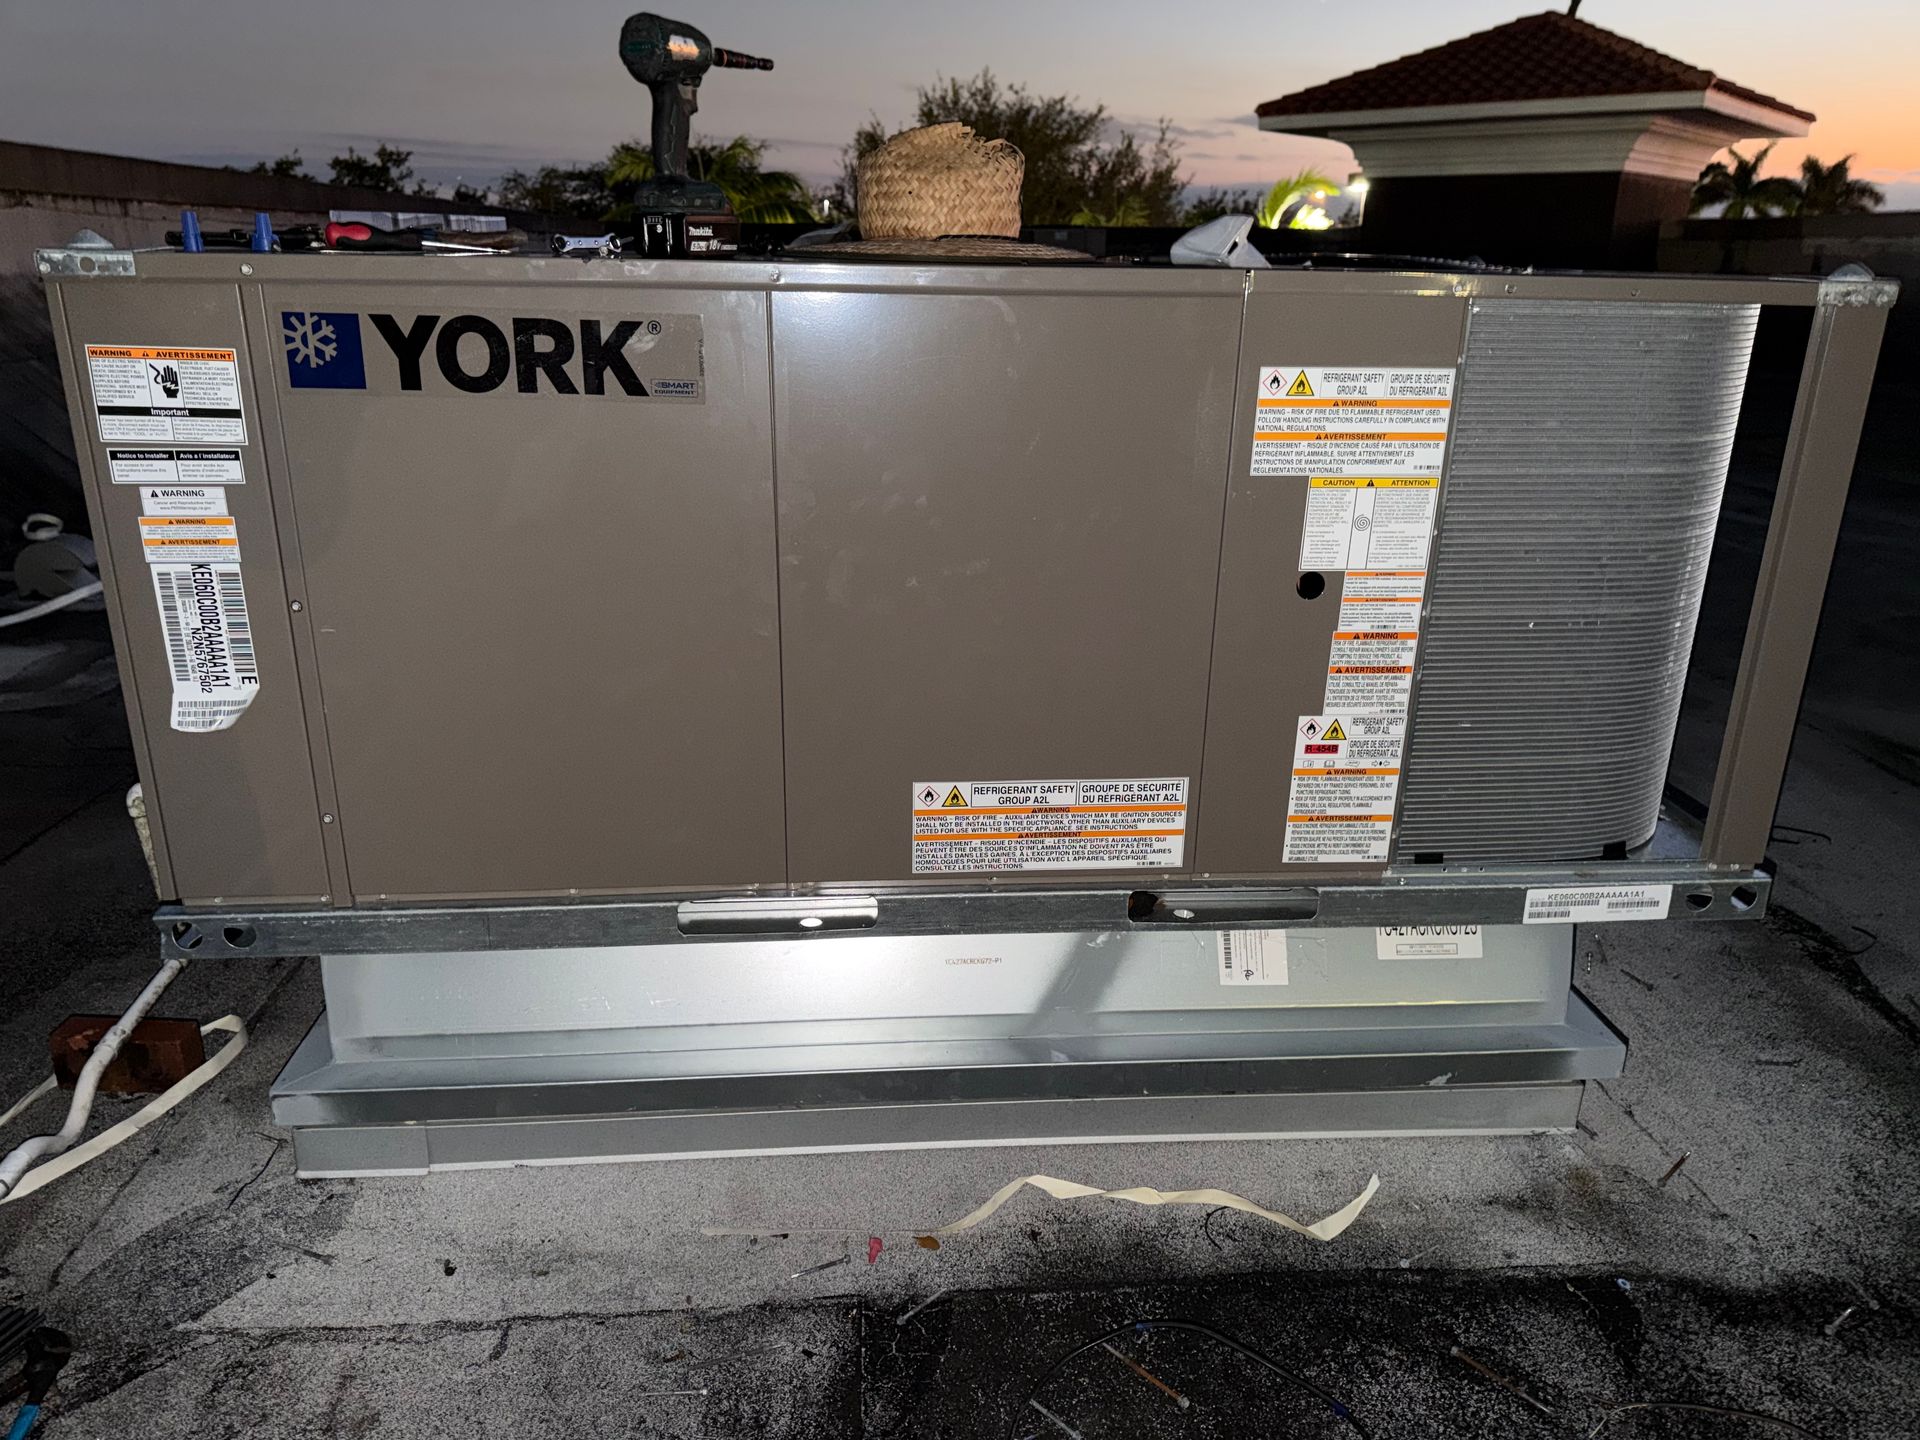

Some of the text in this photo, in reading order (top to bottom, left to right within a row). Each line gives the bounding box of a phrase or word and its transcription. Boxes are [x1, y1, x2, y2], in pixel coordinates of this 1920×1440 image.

[156, 351, 232, 359] AVERTISSEMENT
[368, 313, 650, 396] YORK
[661, 382, 695, 390] SMART
[151, 408, 189, 417] Important
[191, 628, 212, 694] N2N5767502
[242, 676, 258, 684] E
[973, 784, 1074, 795] REFRIGERANT SAFETY
[1081, 783, 1119, 793] GROUPE
[1122, 783, 1134, 792] DE
[998, 795, 1049, 804] GROUP A2L
[1082, 792, 1179, 803] DU RÉFRIGÉRANT A2L
